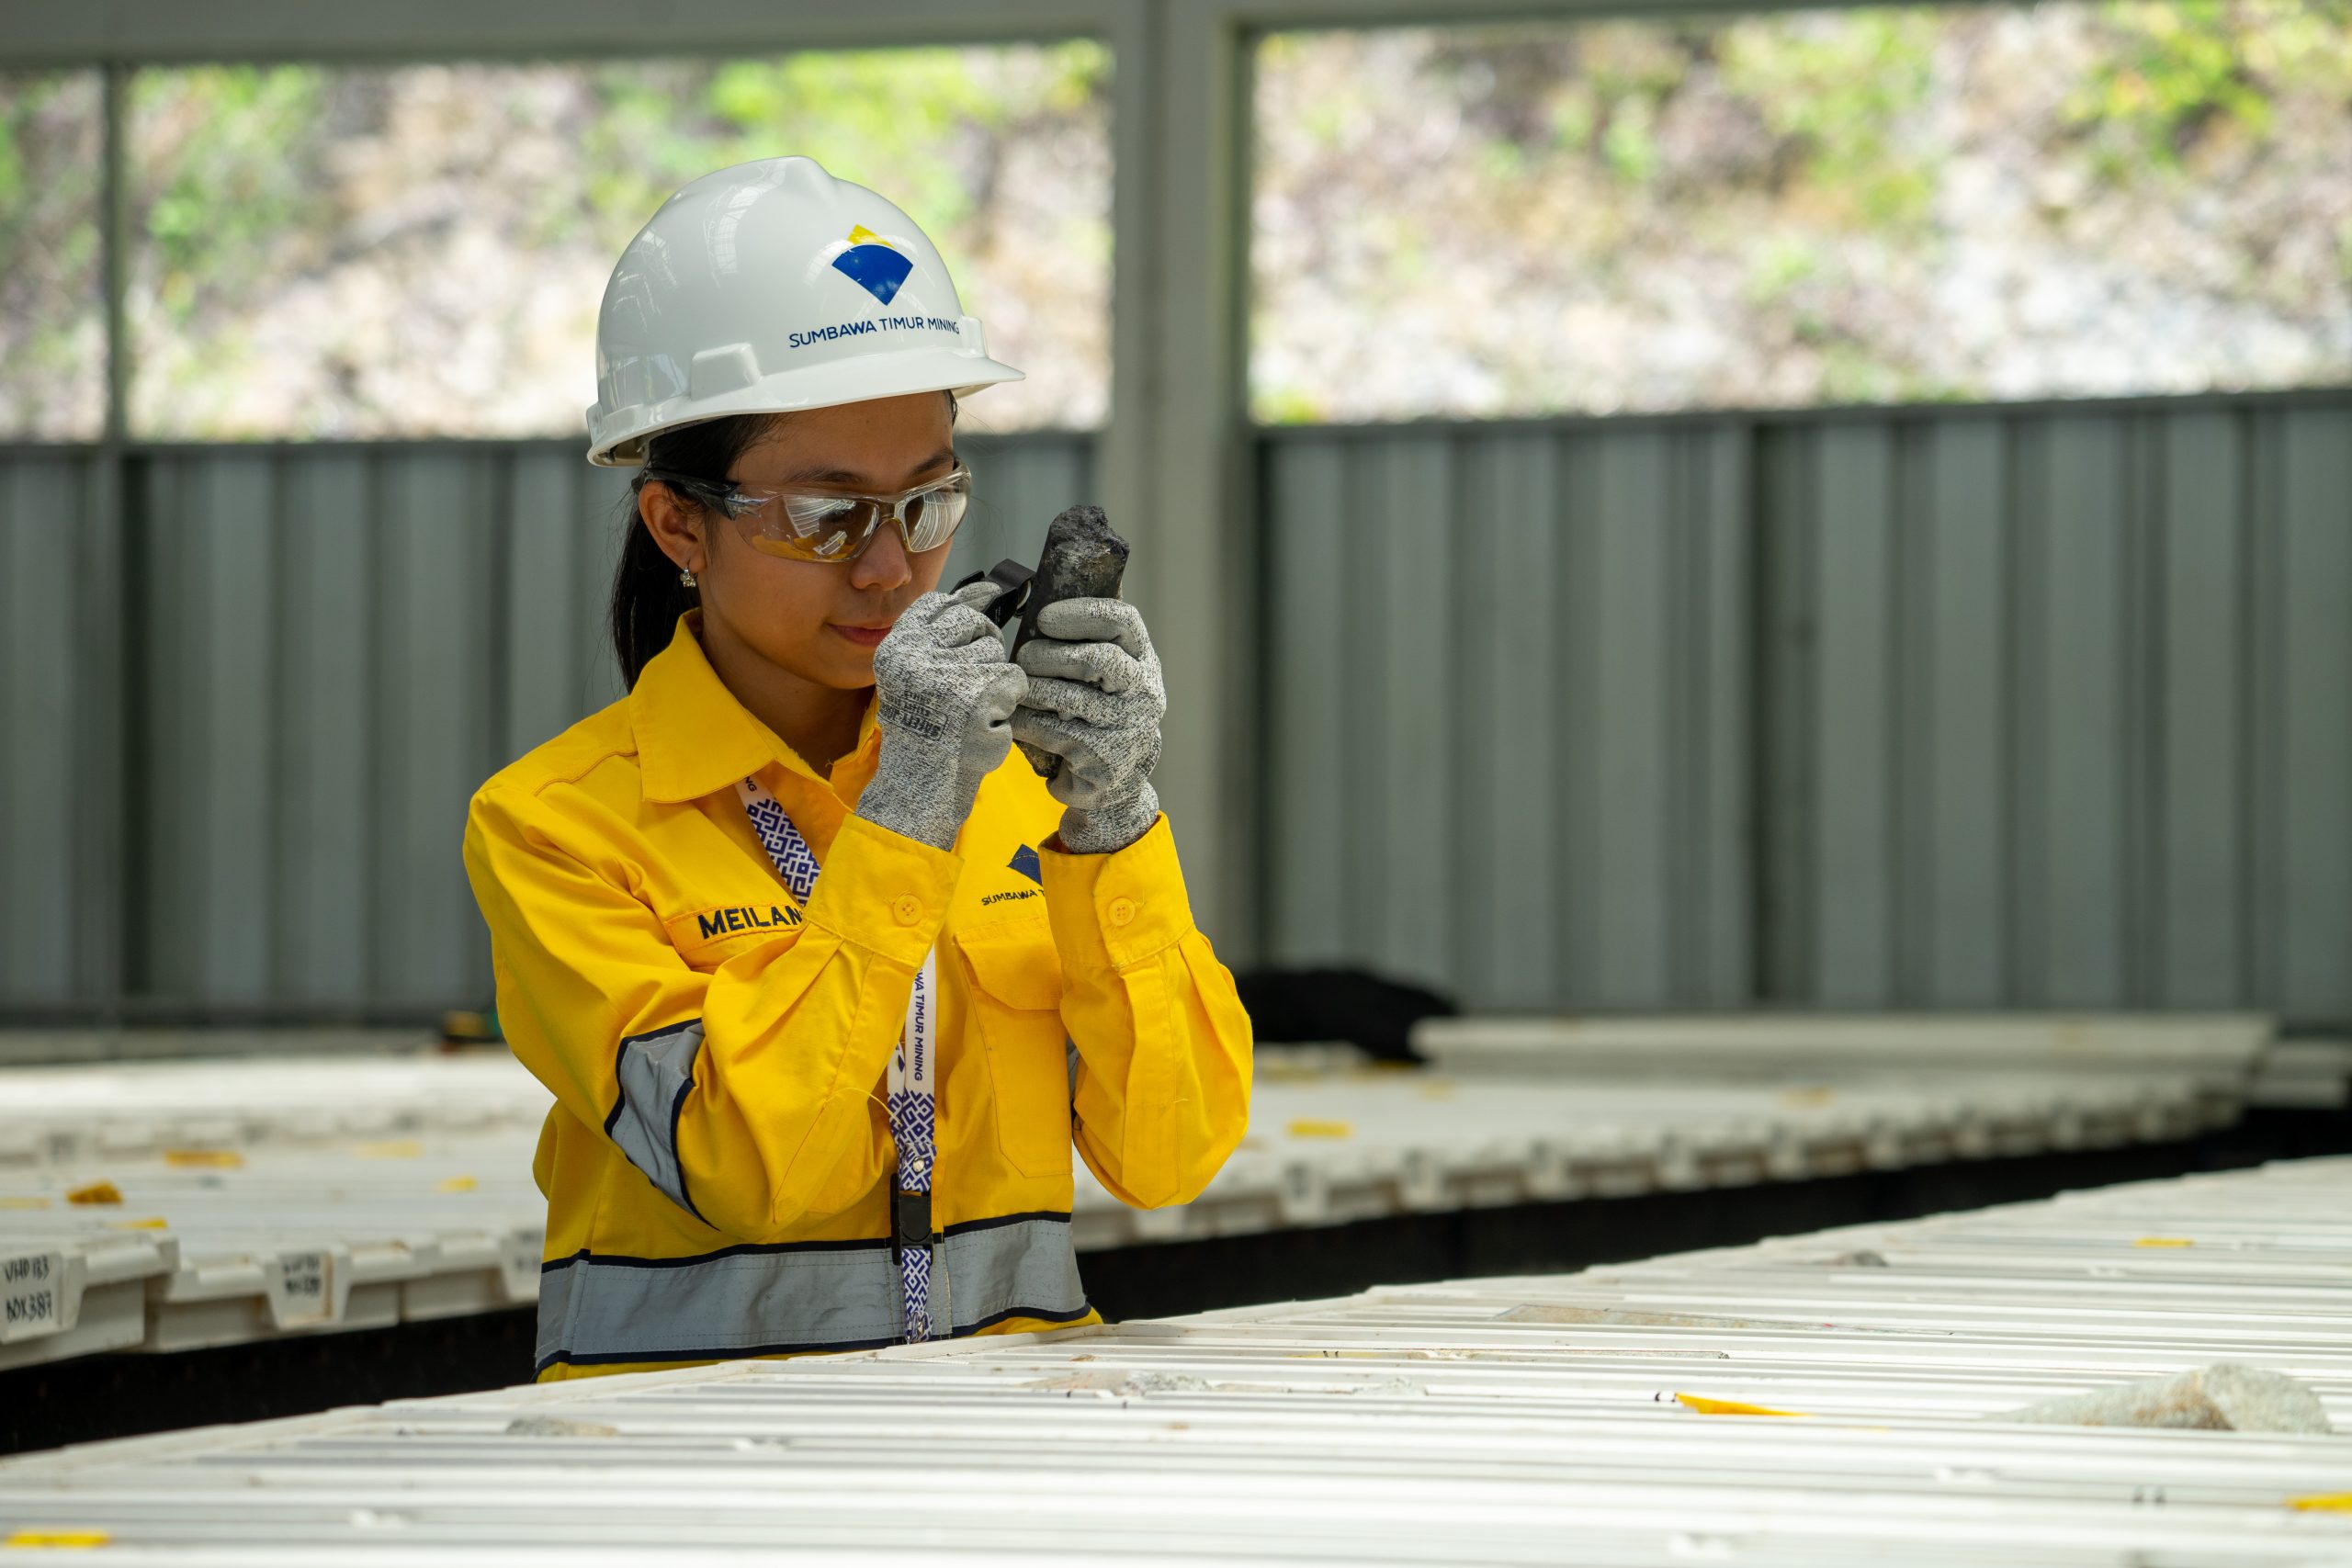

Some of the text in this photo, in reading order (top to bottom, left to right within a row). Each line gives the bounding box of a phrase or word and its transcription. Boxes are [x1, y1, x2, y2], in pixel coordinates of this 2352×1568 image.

[788, 316, 960, 348] SUMBAWA TIMUR MINING
[981, 889, 1038, 906] SUMBAWA
[914, 994, 924, 1034] TIMUR
[914, 1036, 924, 1082] MINING
